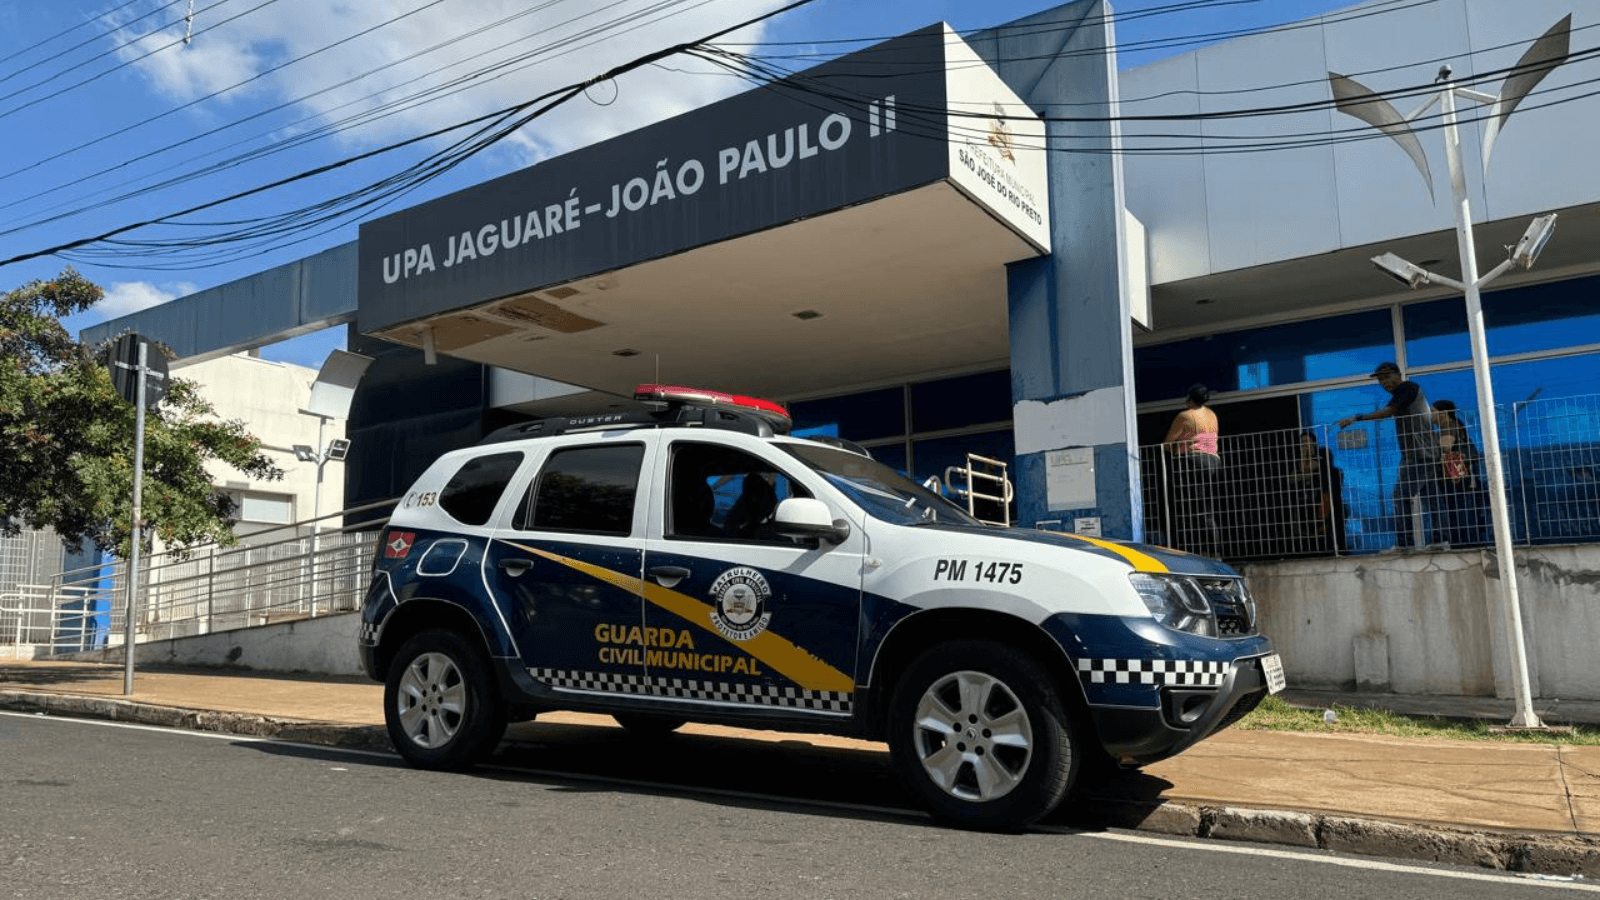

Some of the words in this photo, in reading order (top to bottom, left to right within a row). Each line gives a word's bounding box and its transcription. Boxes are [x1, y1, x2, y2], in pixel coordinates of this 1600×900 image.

[382, 243, 436, 285] UPA
[718, 112, 852, 185] PAULO
[869, 95, 897, 138] II
[959, 149, 975, 172] SÃO
[977, 165, 996, 190] JOSÉ
[997, 180, 1007, 197] DO
[1008, 190, 1021, 208] RIO
[1021, 201, 1042, 226] PRETO
[569, 415, 623, 425] DUSTER
[417, 491, 437, 507] 153
[934, 559, 968, 581] PM
[975, 561, 1023, 584] 1475
[594, 623, 695, 650] GUARDA
[598, 647, 644, 666] CIVIL
[646, 650, 762, 676] MUNICIPAL
